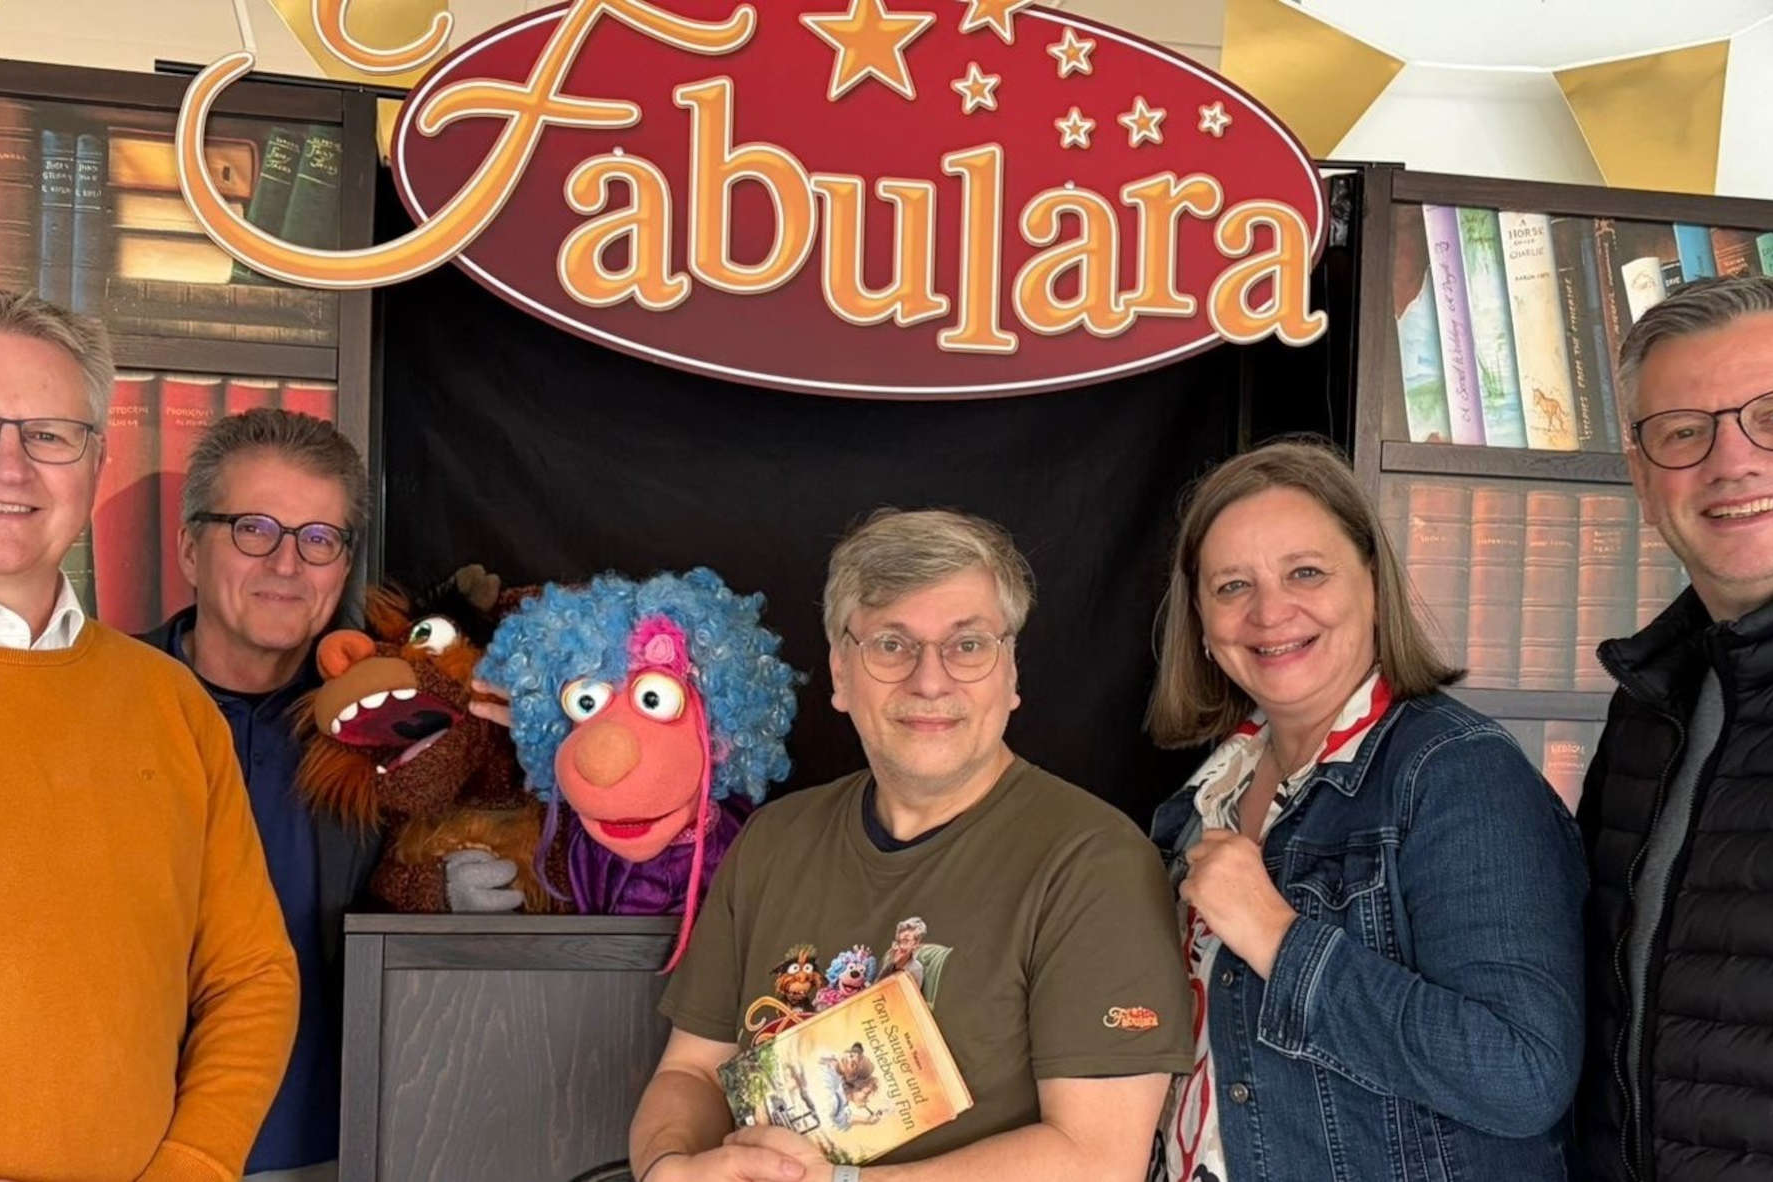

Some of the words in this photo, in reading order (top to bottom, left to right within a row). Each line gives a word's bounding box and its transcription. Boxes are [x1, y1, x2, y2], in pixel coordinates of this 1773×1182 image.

[176, 0, 1328, 353] Fabulara
[862, 1018, 902, 1099] Huckleberry
[895, 1099, 916, 1131] Finn
[872, 994, 890, 1024] Tom
[884, 1024, 914, 1074] Sawyer
[906, 1078, 930, 1105] und
